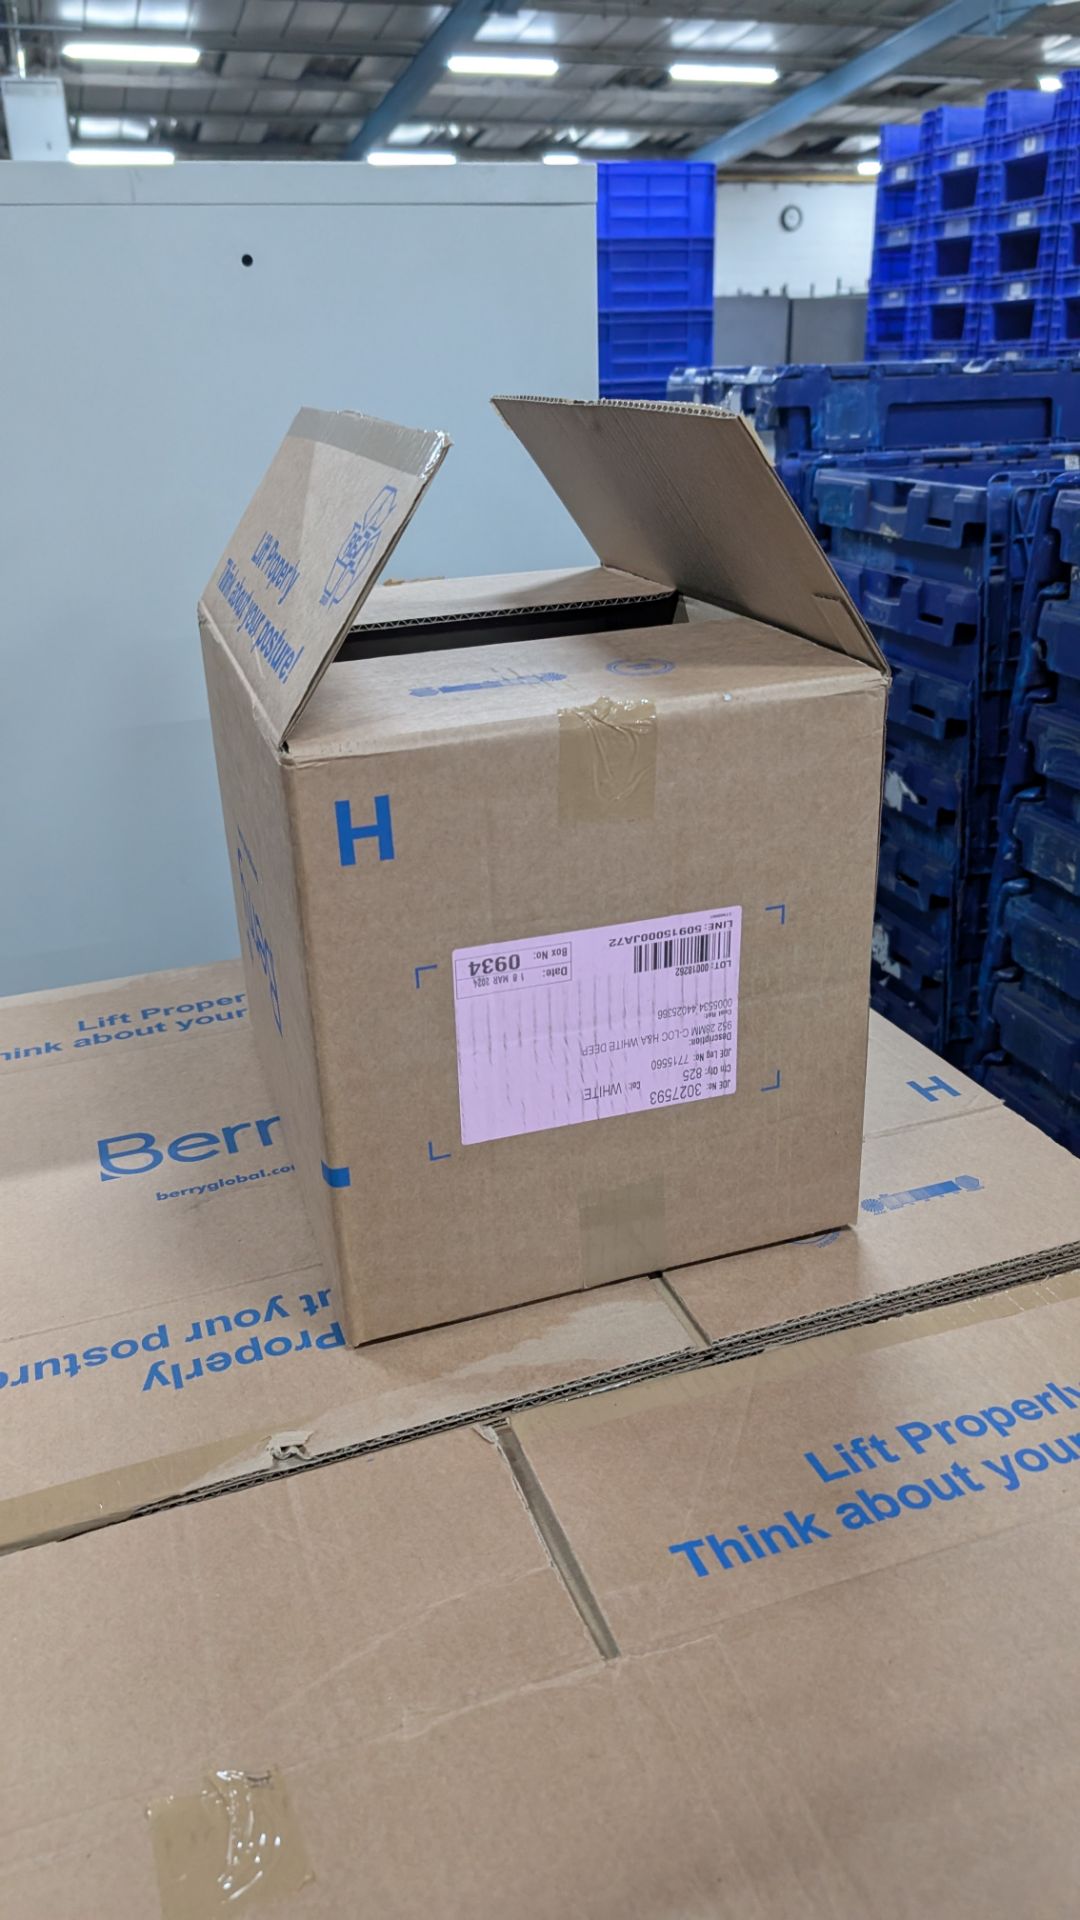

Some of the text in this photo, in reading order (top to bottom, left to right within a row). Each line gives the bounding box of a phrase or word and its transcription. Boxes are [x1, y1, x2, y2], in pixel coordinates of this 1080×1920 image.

[261, 539, 300, 605] Properly
[228, 576, 254, 619] about
[237, 598, 266, 638] your
[250, 619, 305, 684] posture!
[334, 794, 395, 867] H
[608, 920, 733, 948] LINE: 50915000JA72
[468, 947, 568, 977] Box No: 0934
[542, 966, 568, 978] Date:
[710, 959, 732, 970] LOT:
[473, 977, 489, 988] 2024
[493, 975, 509, 985] MAR
[73, 1022, 168, 1049] about
[176, 1007, 249, 1033] your
[78, 993, 247, 1032] Lift Proper
[581, 1021, 732, 1056] 952 28MM C-LOC H&A WHITE DEEP
[689, 1032, 732, 1046] Description:
[651, 1055, 689, 1070] 7715560
[683, 1067, 702, 1081] 825
[584, 1082, 622, 1100] WHITE
[650, 1083, 702, 1105] 3027593
[906, 1075, 961, 1102] H
[97, 1115, 281, 1181] Berr
[185, 1294, 290, 1343] your
[141, 1321, 346, 1392] Properly
[804, 1434, 900, 1483] Lift
[668, 1510, 832, 1578] Think
[835, 1461, 985, 1530] about
